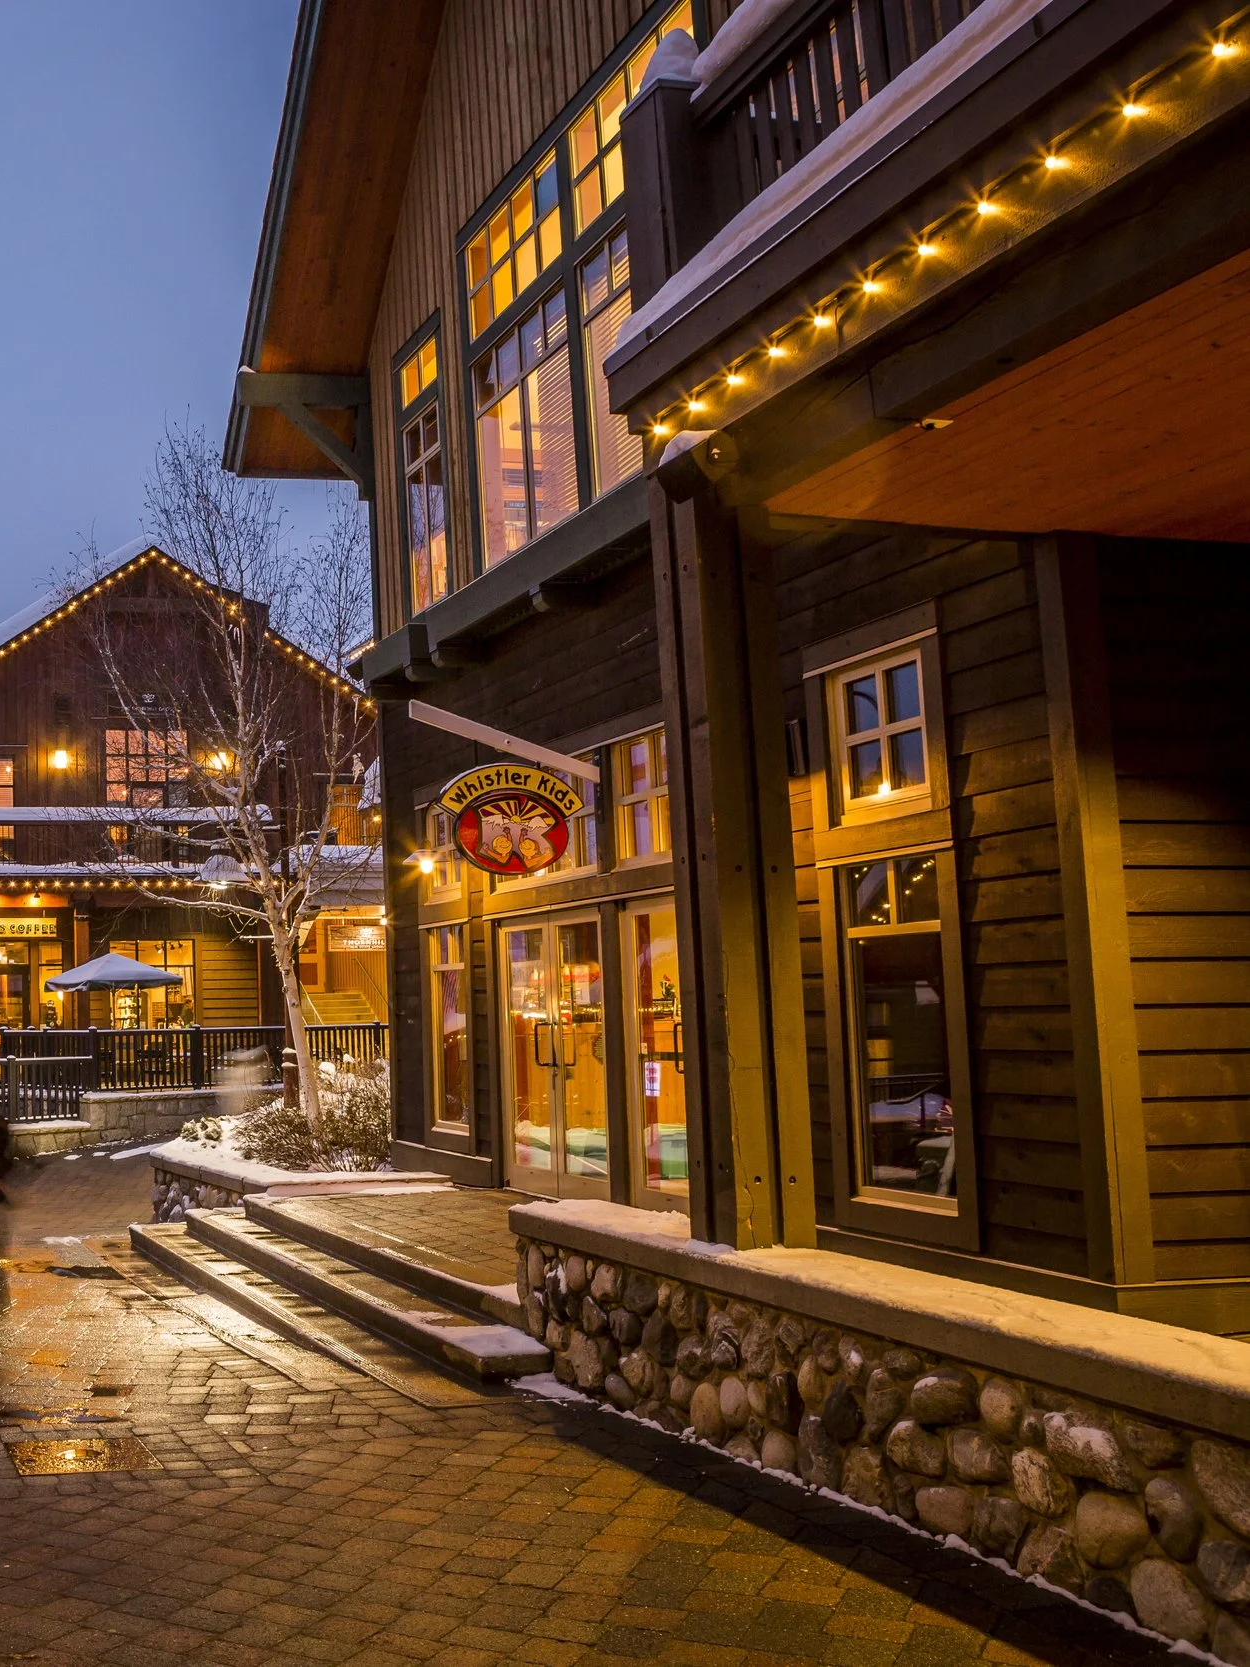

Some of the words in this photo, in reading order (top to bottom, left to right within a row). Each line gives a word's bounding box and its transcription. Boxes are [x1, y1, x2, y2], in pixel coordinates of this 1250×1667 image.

[449, 769, 531, 805] Whistler
[537, 775, 575, 811] Kids
[9, 924, 57, 934] COFFEE
